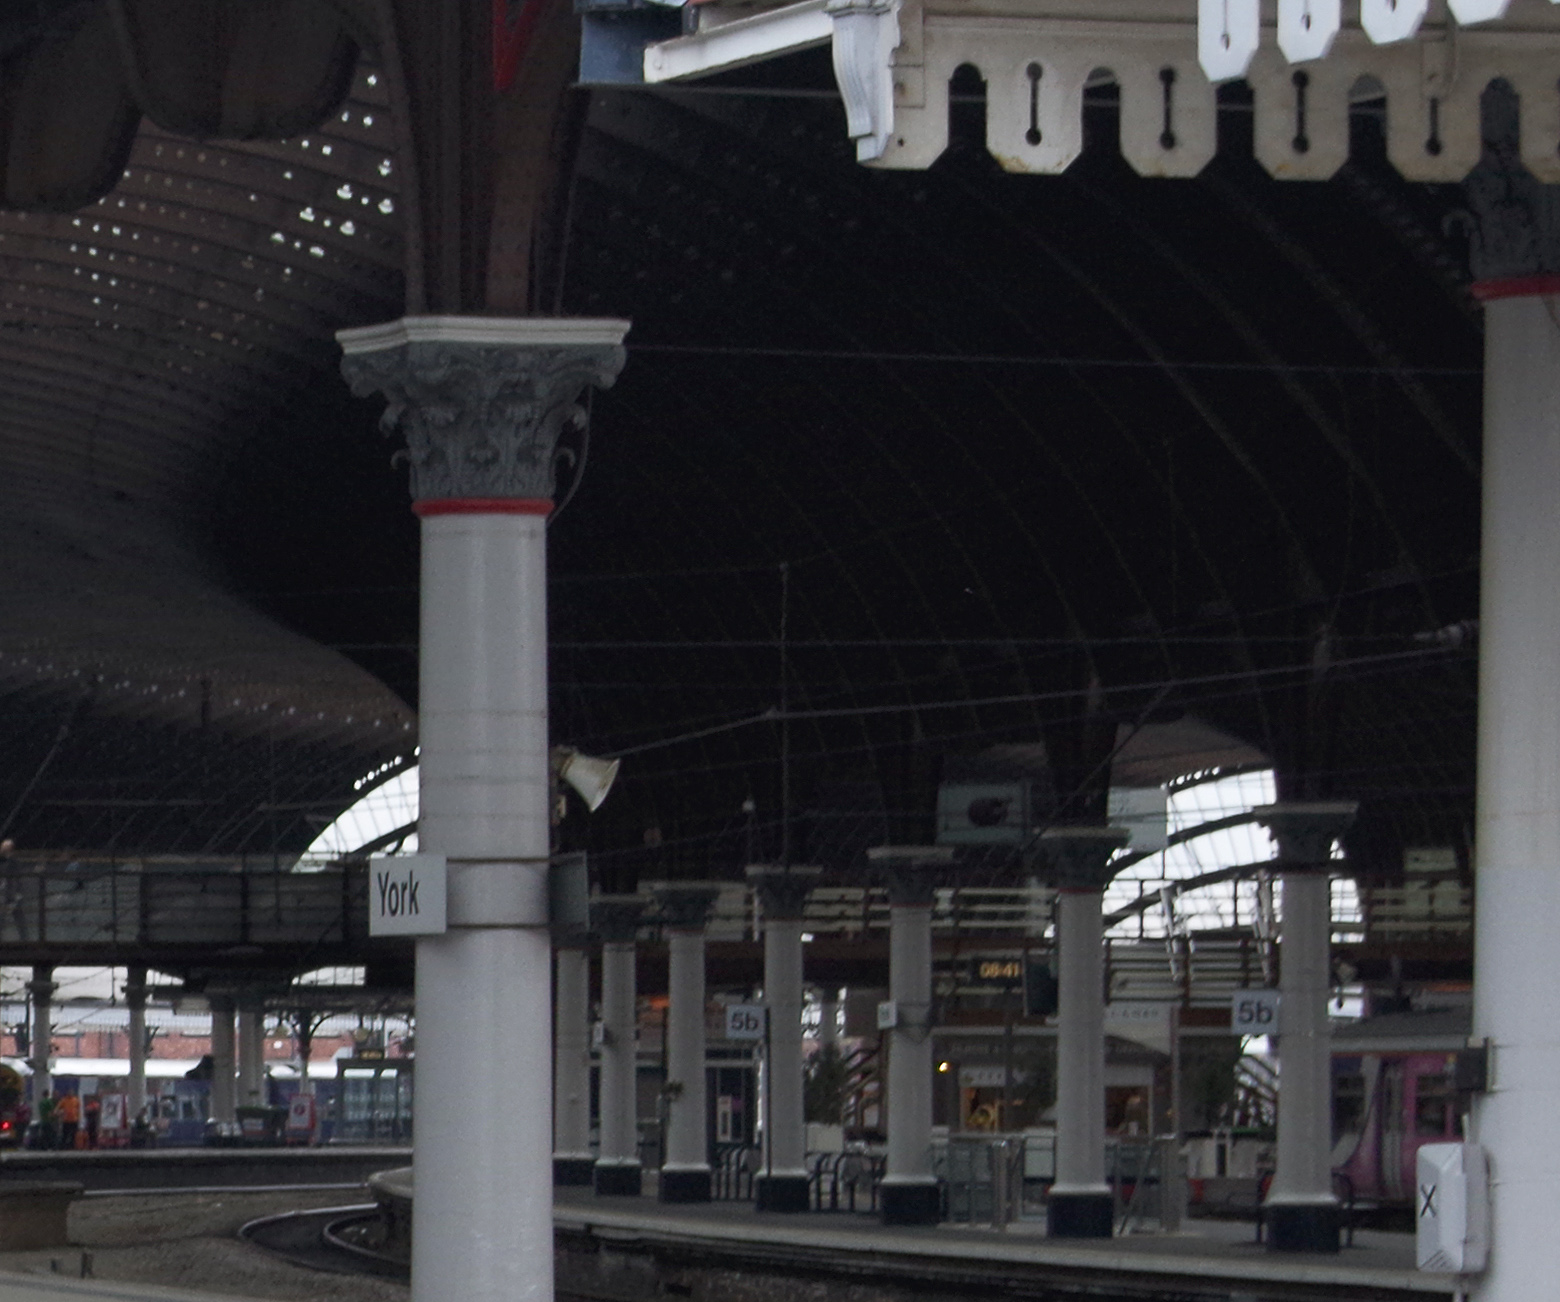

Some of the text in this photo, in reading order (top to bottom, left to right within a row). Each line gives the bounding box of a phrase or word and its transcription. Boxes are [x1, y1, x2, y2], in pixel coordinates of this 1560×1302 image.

[378, 870, 419, 917] York
[731, 1012, 758, 1031] 5b
[1238, 1000, 1273, 1024] 5b
